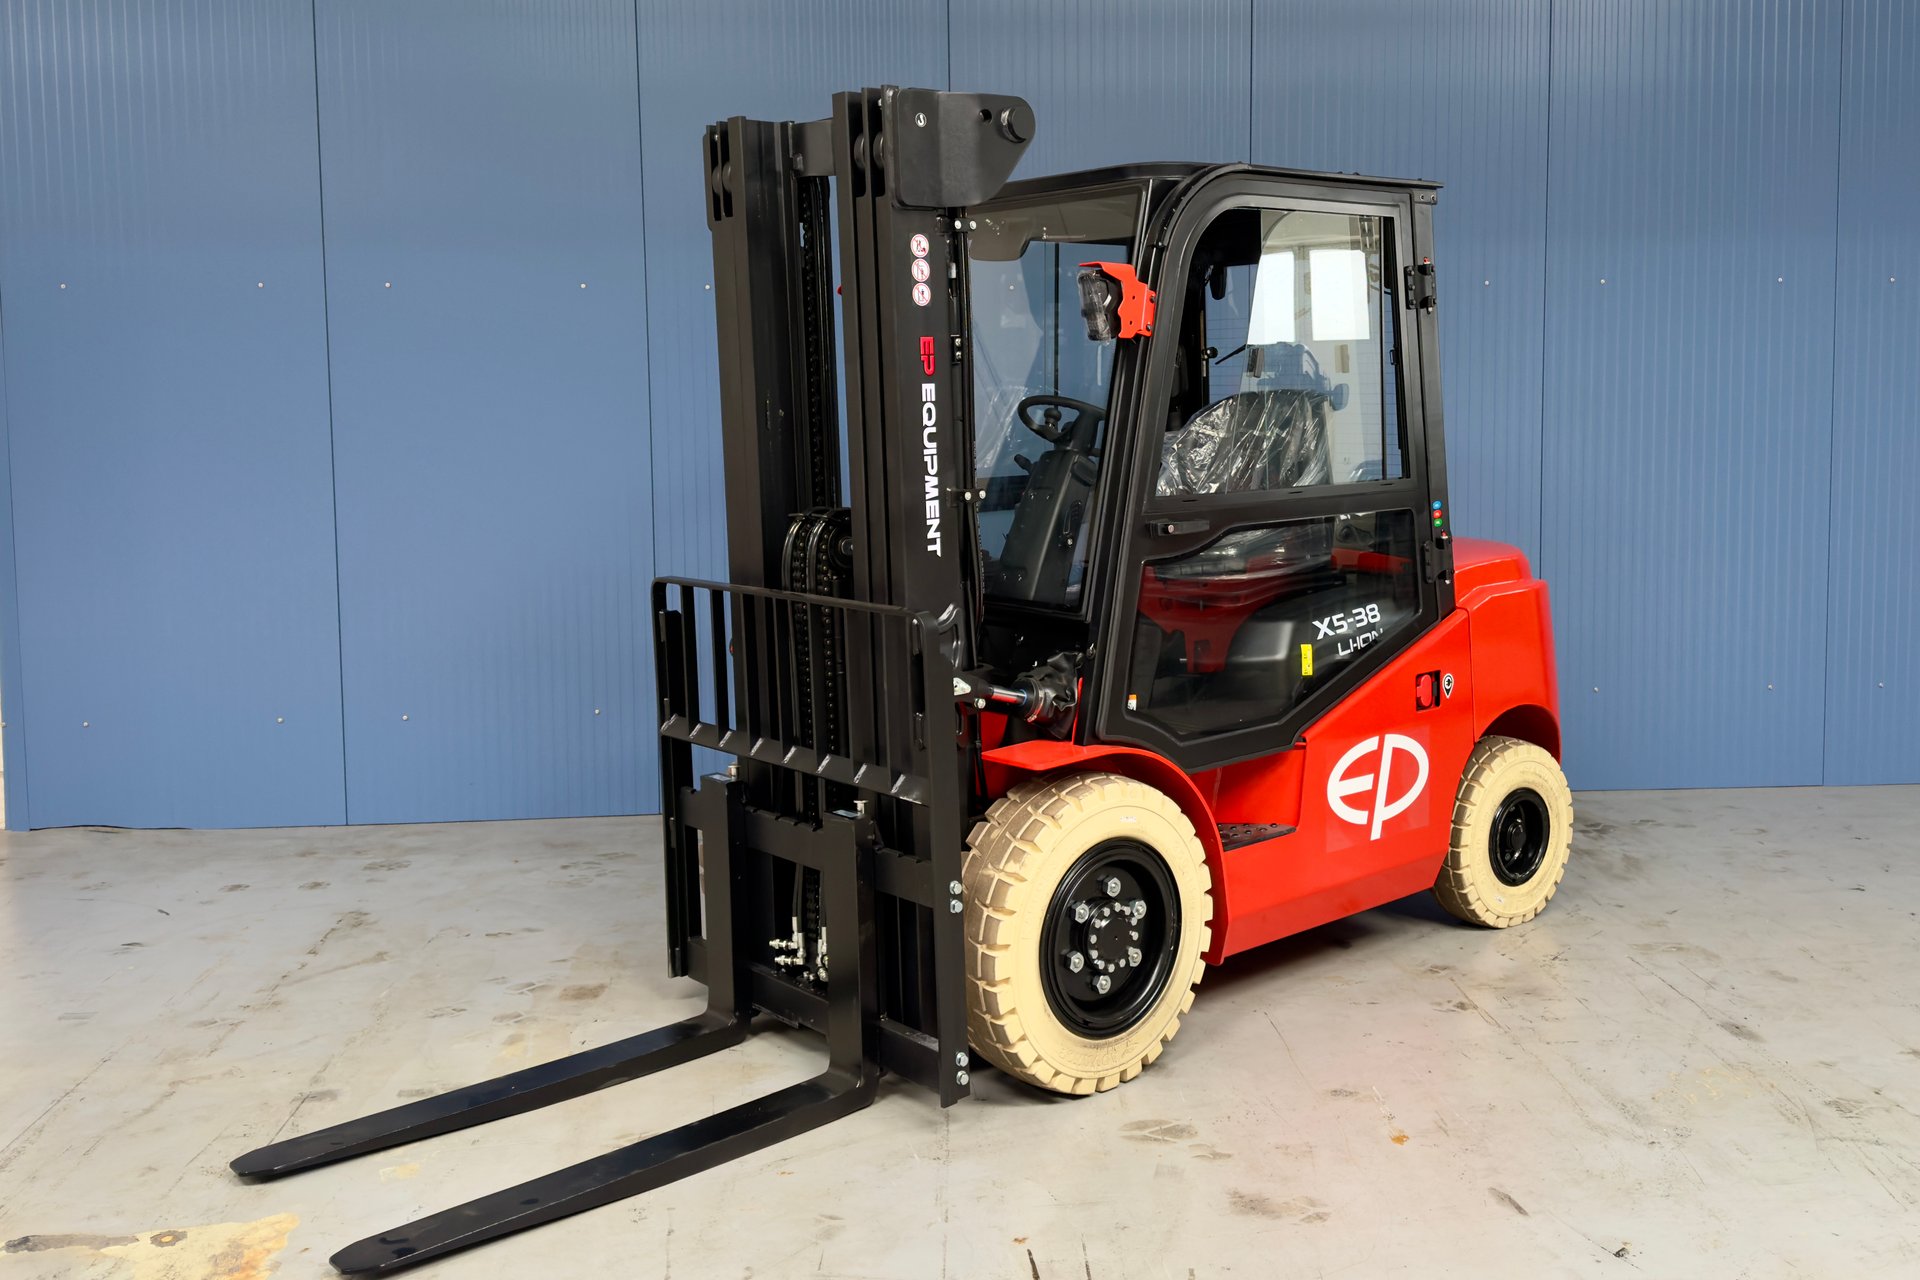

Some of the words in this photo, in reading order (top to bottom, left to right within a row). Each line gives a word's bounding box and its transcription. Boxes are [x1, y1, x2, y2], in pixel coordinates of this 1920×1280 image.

[920, 336, 936, 376] EP
[921, 383, 941, 558] EQUIPMENT
[1312, 603, 1381, 640] X5-38
[1327, 733, 1430, 841] EP
